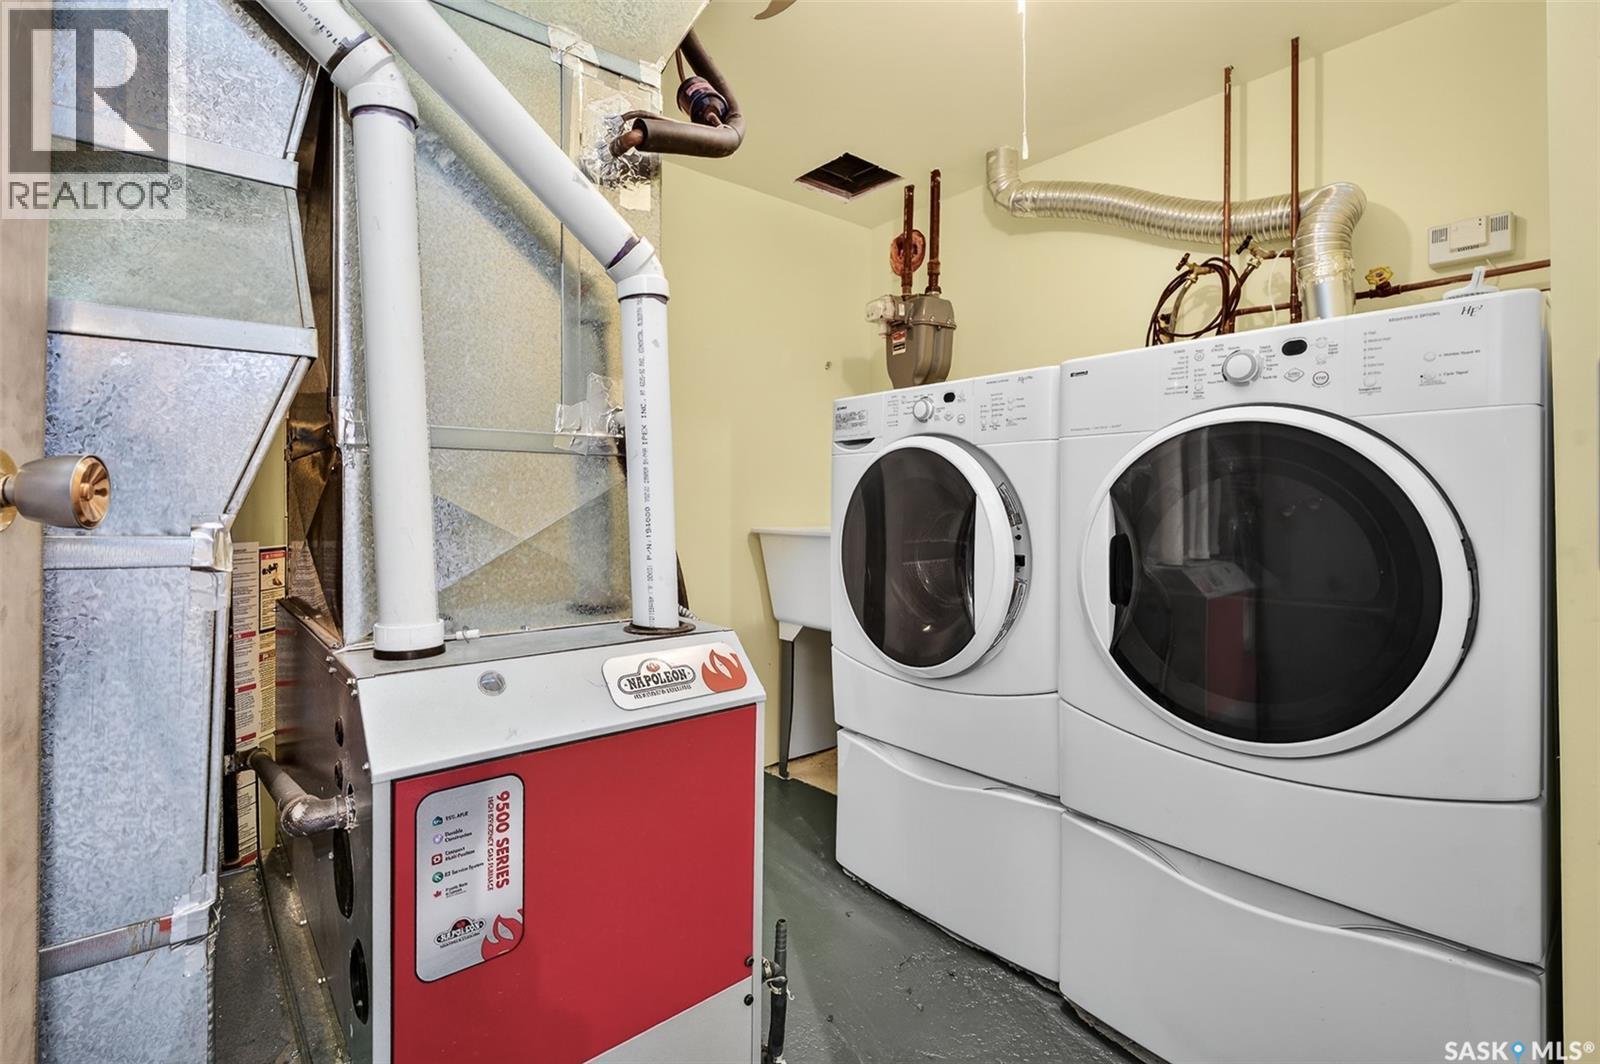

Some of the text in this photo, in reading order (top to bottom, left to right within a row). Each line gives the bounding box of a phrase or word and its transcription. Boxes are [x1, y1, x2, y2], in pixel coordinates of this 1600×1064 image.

[626, 668, 688, 691] NAPOLEON
[495, 791, 510, 889] 9500 SERIES
